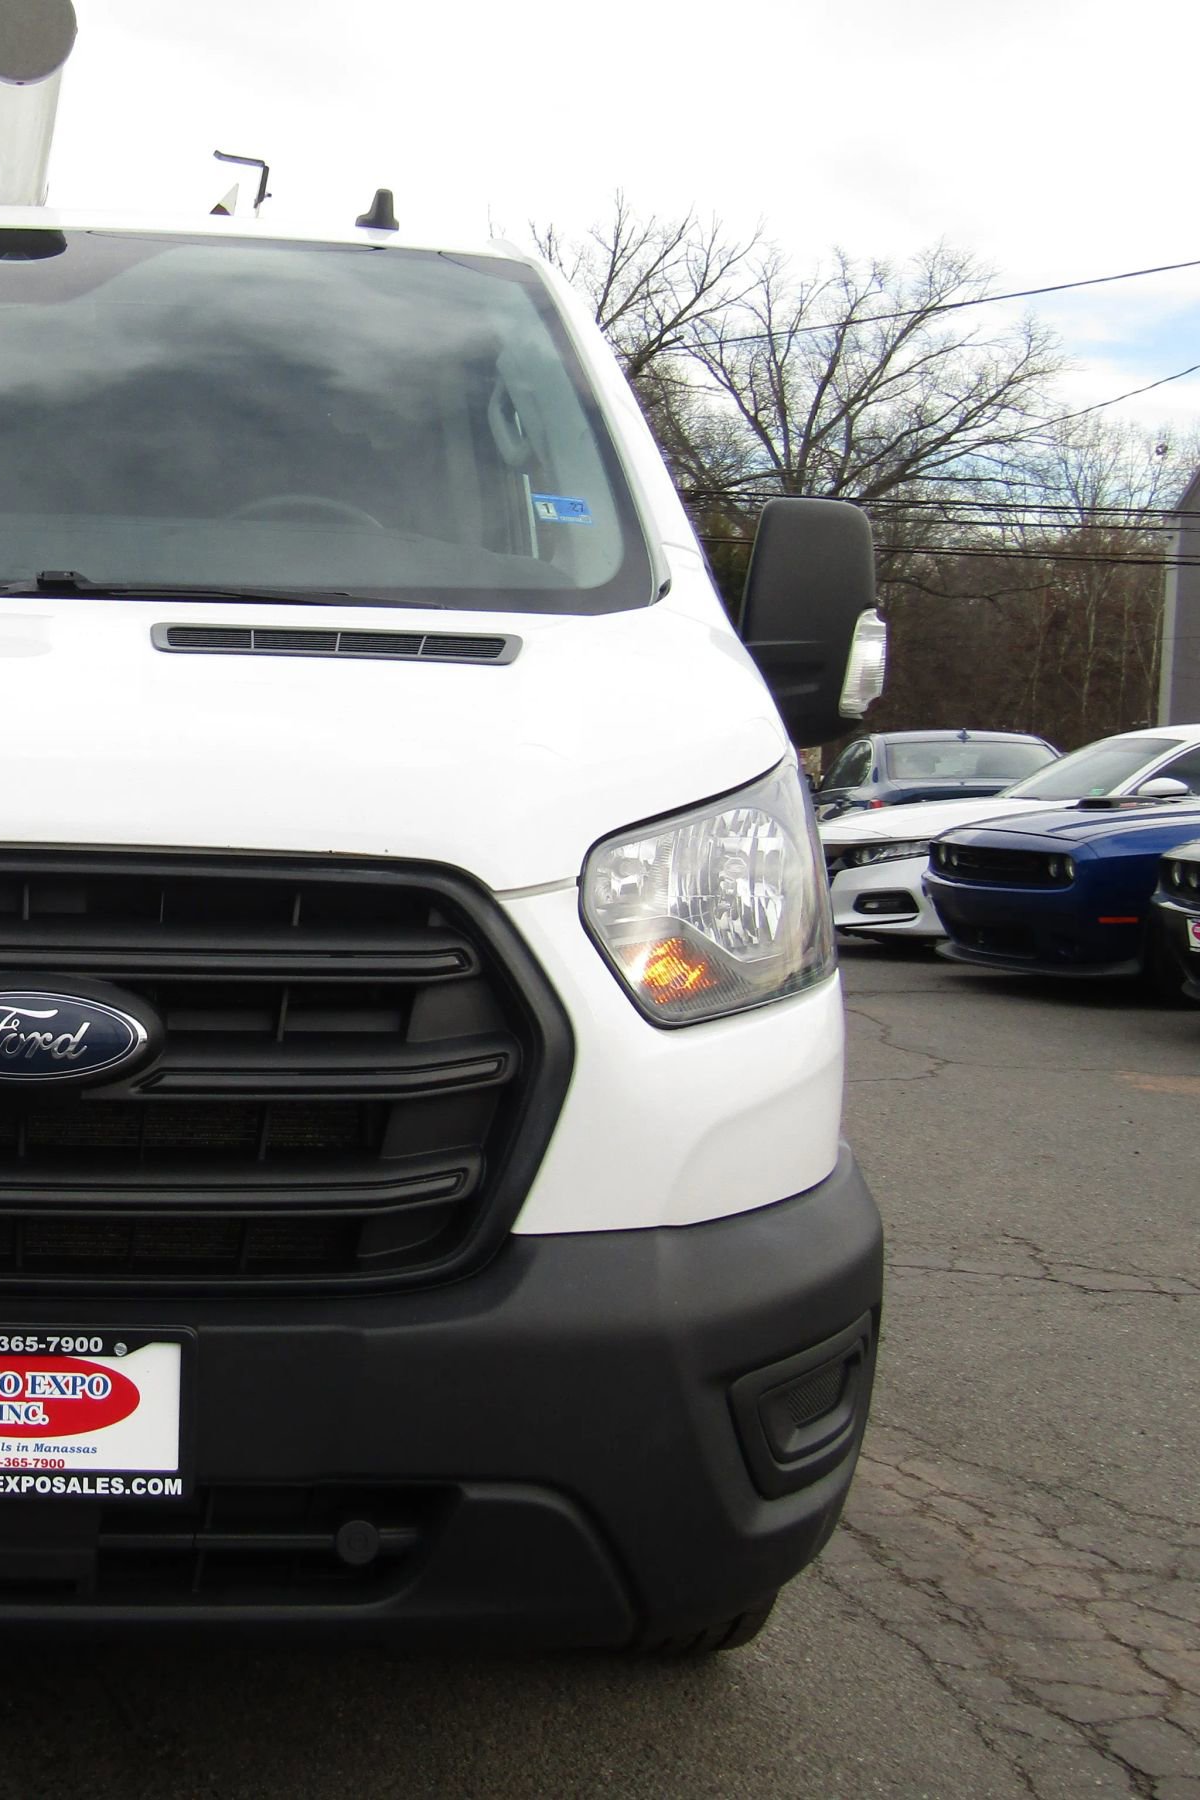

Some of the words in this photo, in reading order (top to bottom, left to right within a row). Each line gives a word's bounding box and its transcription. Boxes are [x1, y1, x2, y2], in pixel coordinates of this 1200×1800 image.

[25, 1372, 112, 1399] EXPO
[16, 1442, 29, 1452] in
[33, 1442, 98, 1454] Manassas
